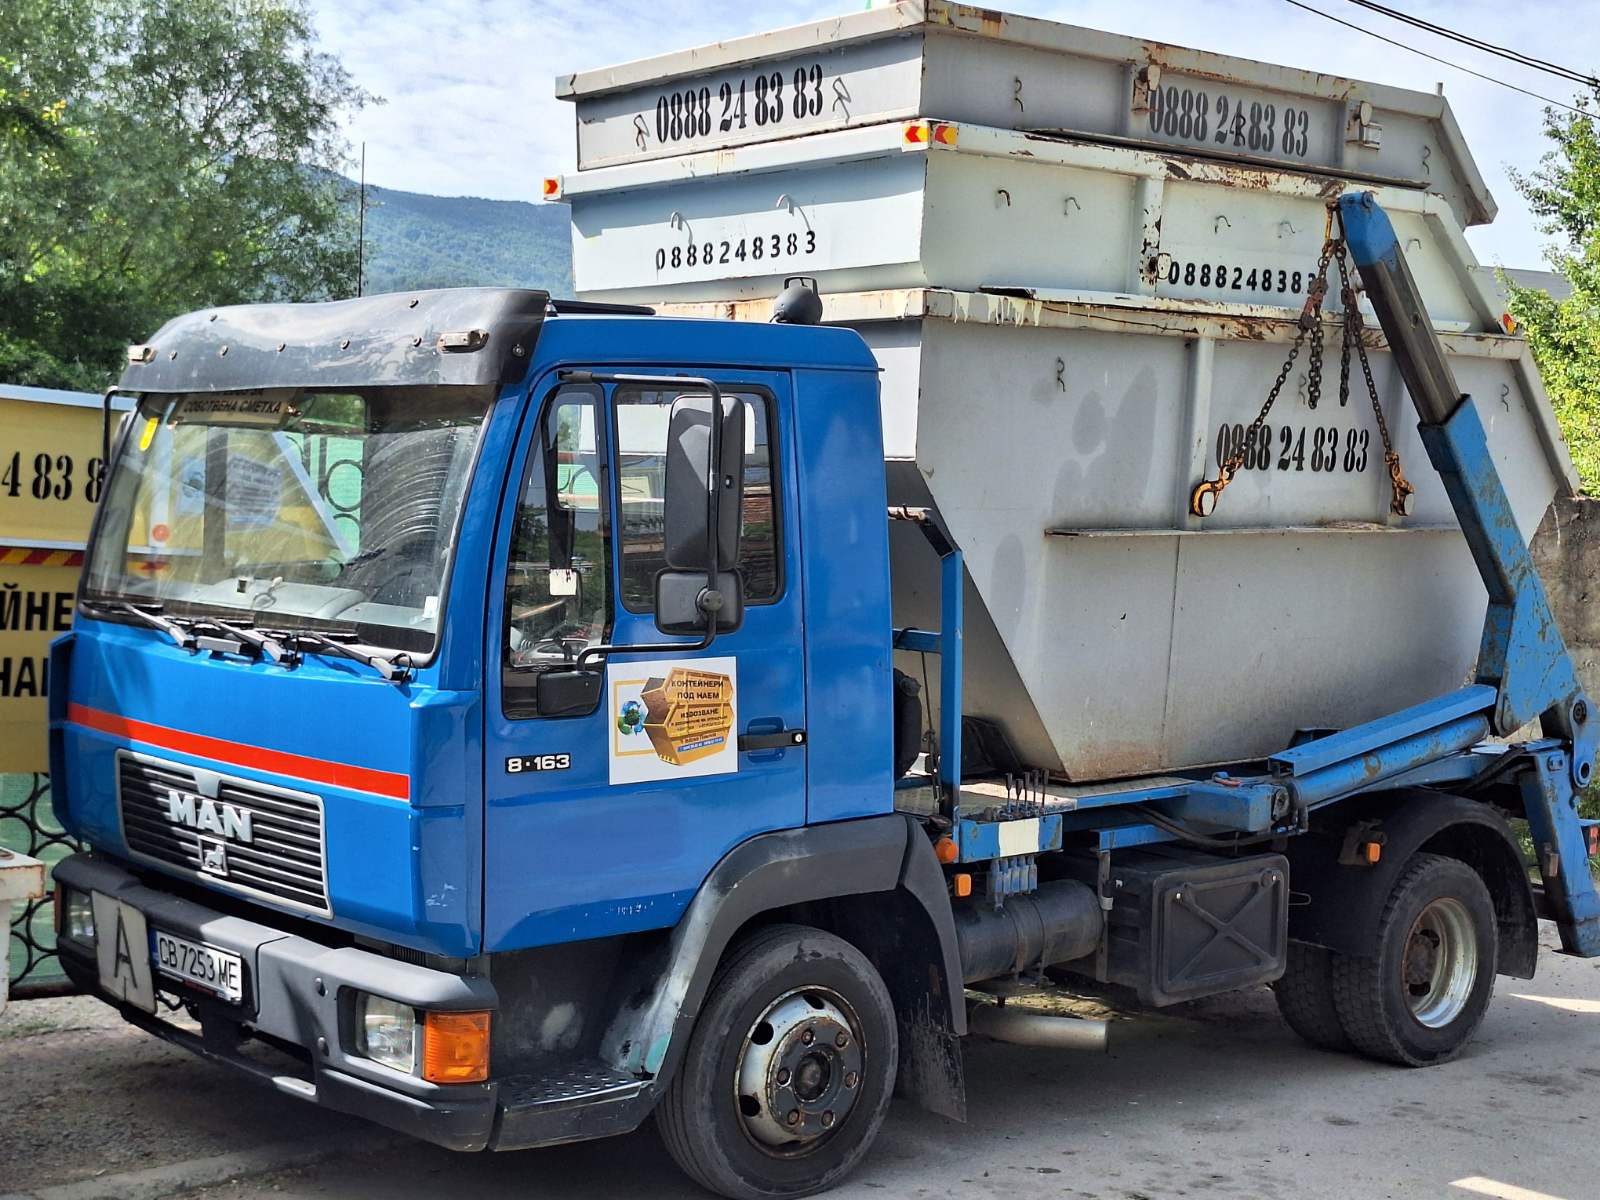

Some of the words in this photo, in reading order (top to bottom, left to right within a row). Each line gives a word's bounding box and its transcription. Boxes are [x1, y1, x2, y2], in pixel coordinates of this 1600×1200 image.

[656, 86, 712, 144] 0888
[719, 78, 748, 132] 24
[754, 71, 784, 126] 83
[793, 63, 823, 119] 83
[1149, 84, 1209, 142] 0888
[1214, 95, 1243, 147] 24
[1248, 102, 1276, 152] 83
[1282, 108, 1309, 158] 83
[655, 230, 816, 270] 0888248383
[1277, 425, 1306, 472] 24
[1310, 426, 1339, 473] 83
[1343, 428, 1370, 473] 83
[32, 453, 73, 500] 83
[671, 679, 724, 688] КОНТЕЙНЕРИ
[677, 691, 695, 700] ПОД
[696, 691, 720, 700] НАЕМ
[167, 790, 253, 843] MAN
[114, 906, 138, 990] A
[179, 944, 216, 981] 7253
